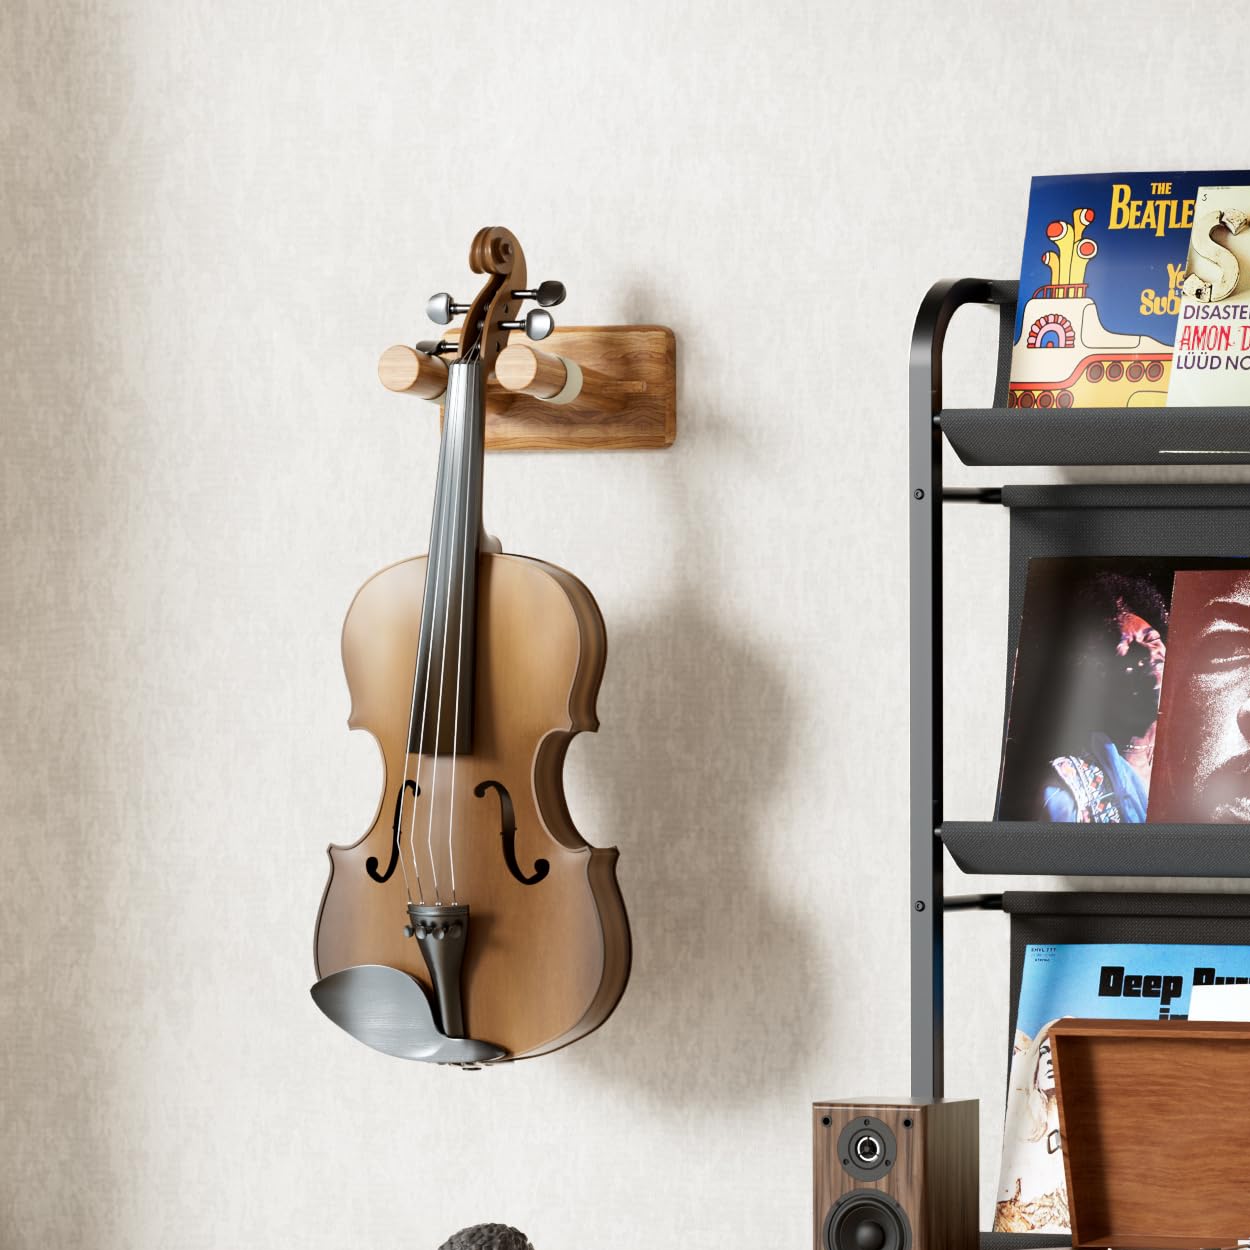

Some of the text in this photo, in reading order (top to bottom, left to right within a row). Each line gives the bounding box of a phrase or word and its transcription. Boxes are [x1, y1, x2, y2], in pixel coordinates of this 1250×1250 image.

[1151, 182, 1172, 195] THE
[1108, 184, 1195, 237] BEATLE
[1179, 324, 1233, 352] AMON
[1176, 352, 1222, 370] LÜÜD
[1098, 966, 1184, 1006] Deep
